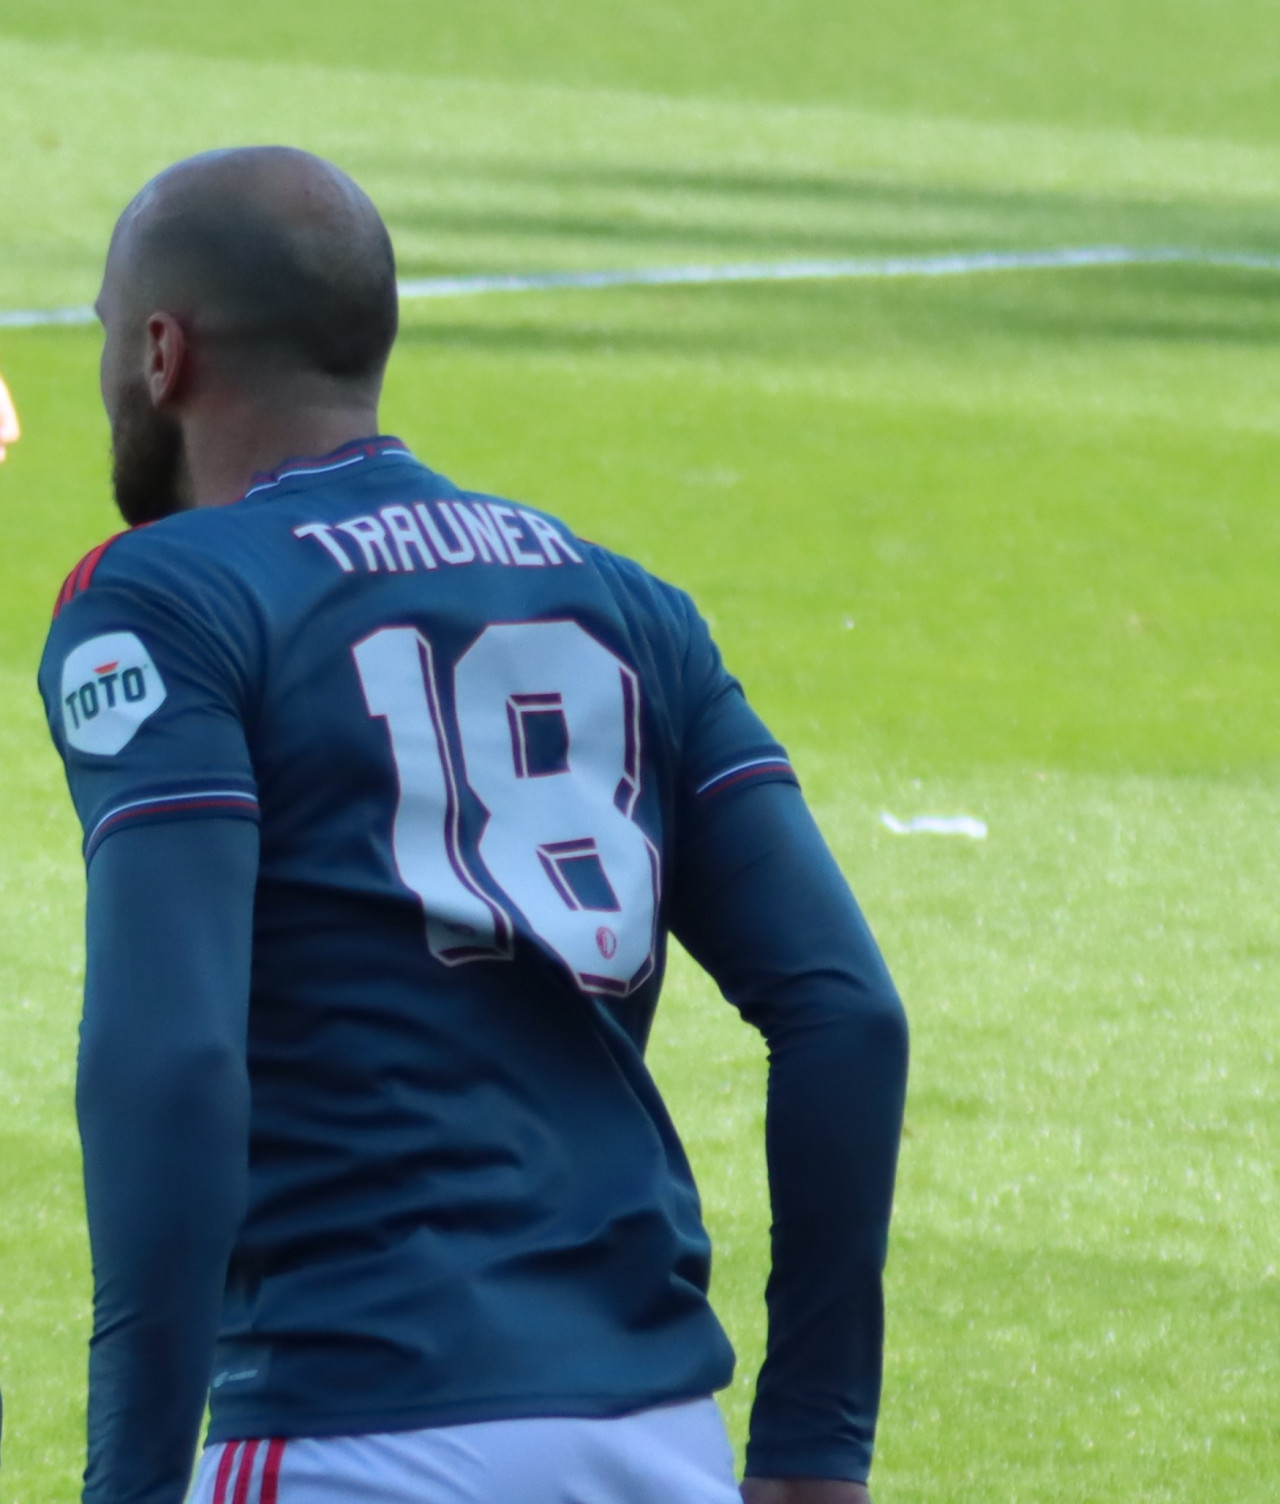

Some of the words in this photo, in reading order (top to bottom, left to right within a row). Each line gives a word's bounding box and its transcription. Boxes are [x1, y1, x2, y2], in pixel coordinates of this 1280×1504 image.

[293, 501, 584, 573] TRAUNER
[64, 665, 147, 730] TOTO
[351, 620, 662, 998] 18
